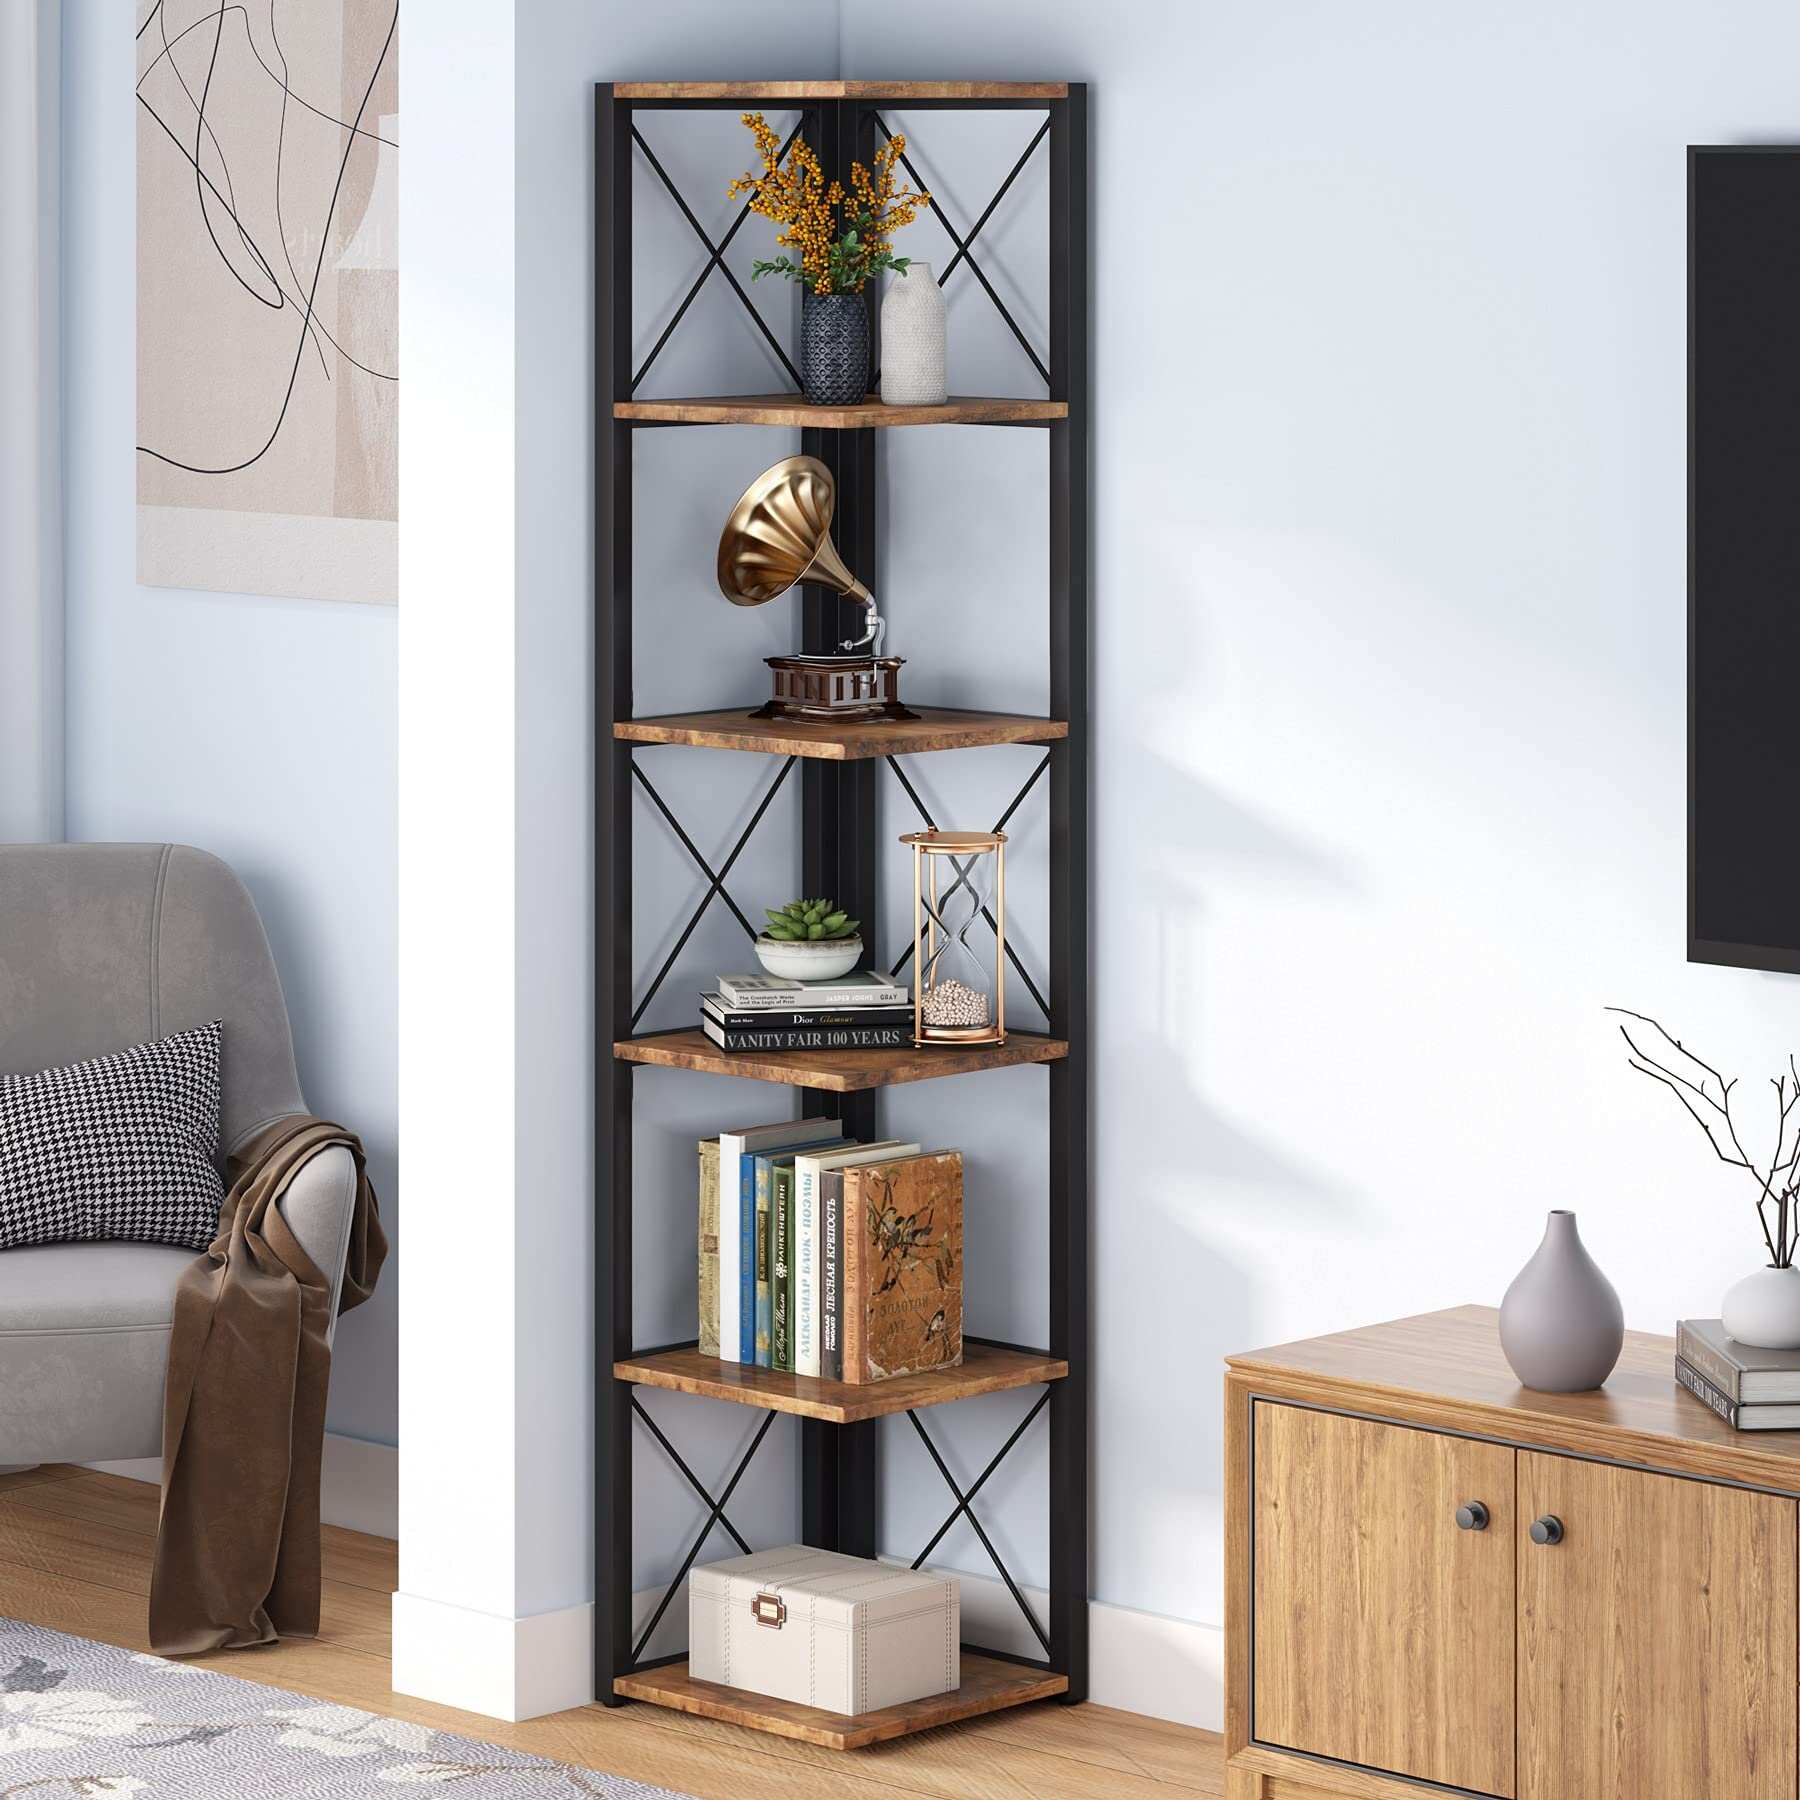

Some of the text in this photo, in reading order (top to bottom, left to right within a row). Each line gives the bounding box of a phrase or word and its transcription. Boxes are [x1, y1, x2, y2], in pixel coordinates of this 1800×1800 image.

[880, 993, 897, 1001] GRAY
[793, 1014, 814, 1024] Dior
[727, 1030, 900, 1048] VANITY FAIR 100 YEARS
[825, 1198, 837, 1312] ЛЕСНАЯ КРЕПОСТЬ
[800, 1172, 813, 1359] АЛЕКСАНДР БЛОК ПОЭМЫ
